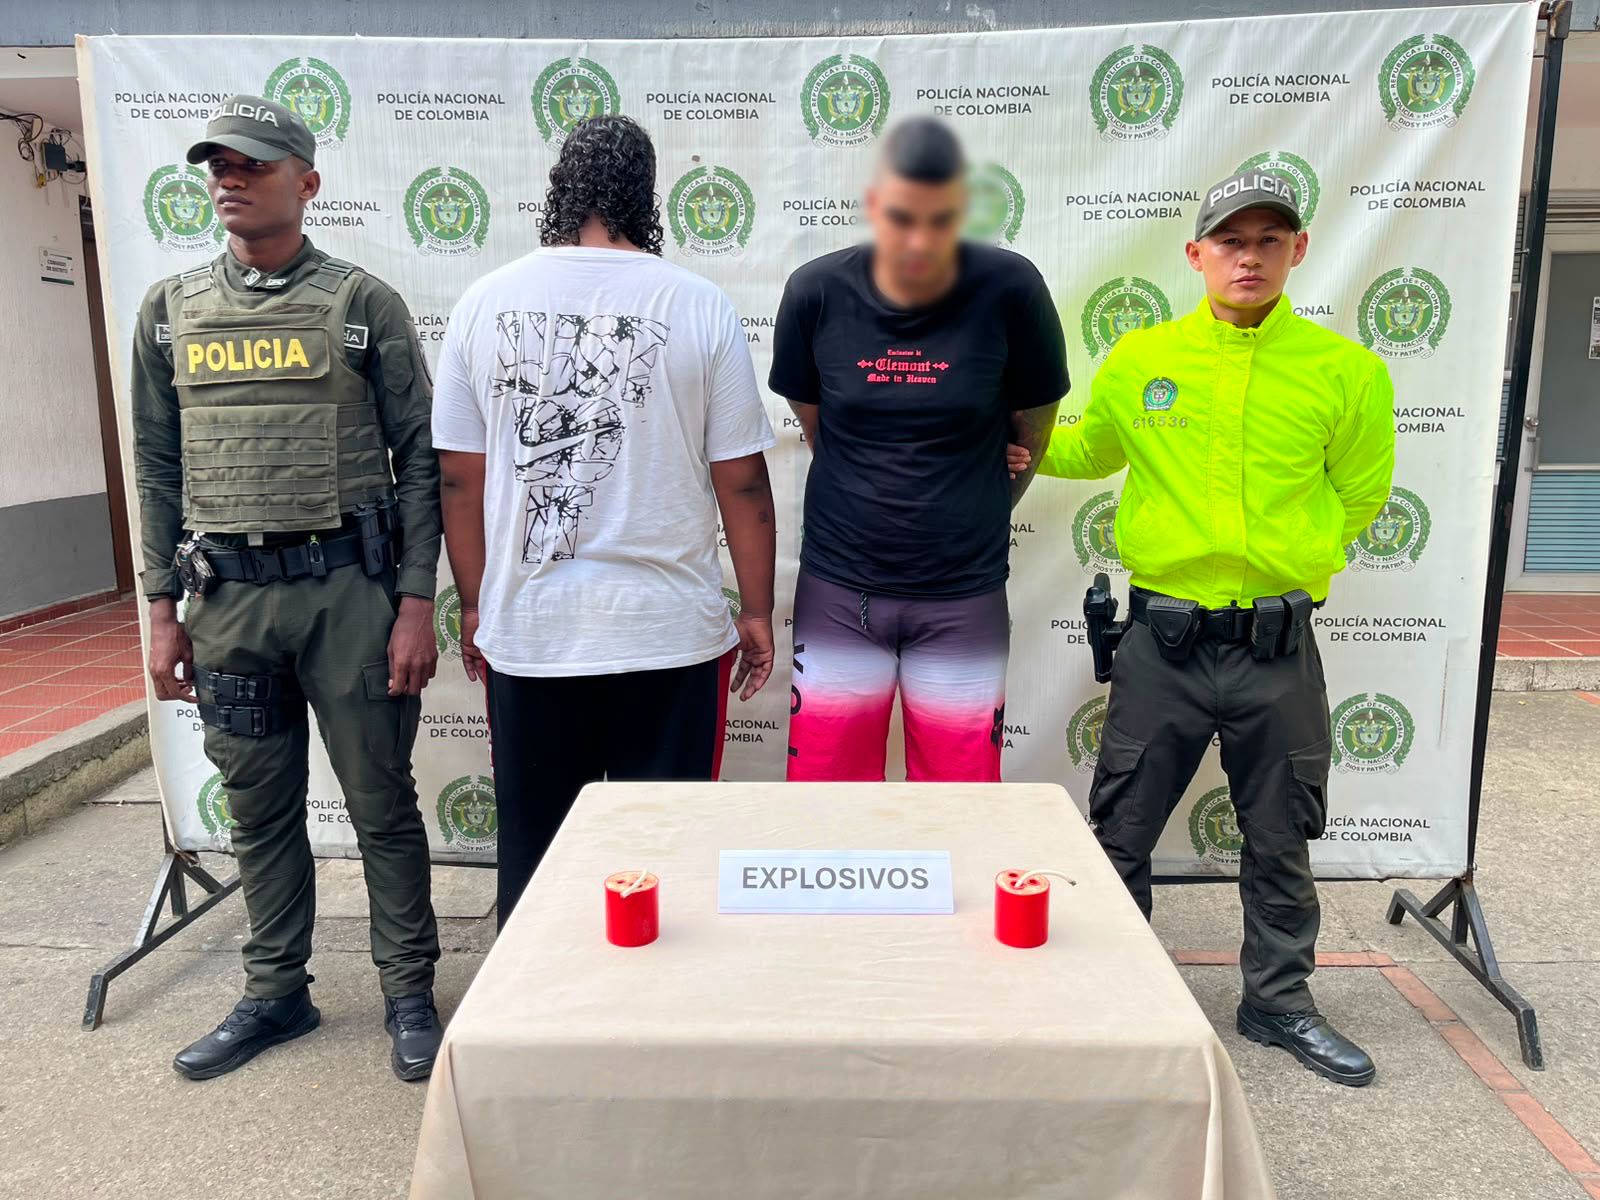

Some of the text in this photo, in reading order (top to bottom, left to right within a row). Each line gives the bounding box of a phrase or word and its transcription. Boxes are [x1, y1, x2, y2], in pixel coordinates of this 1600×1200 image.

[1390, 49, 1417, 88] REPUBLICA
[1442, 48, 1462, 85] COLOMBIA
[1101, 60, 1126, 100] REPUBLICA
[1151, 60, 1171, 97] COLOMBIA
[1212, 73, 1350, 88] POLICÍA NACIONAL
[275, 72, 294, 101] PUBLICA
[318, 73, 340, 109] COLOMBIA
[543, 72, 564, 109] REPUBLICA
[588, 72, 609, 109] COLOMBIA
[812, 68, 834, 106] REPUBLICA
[858, 69, 879, 105] COLOMBIA
[917, 85, 1050, 100] POLICÍA NACIONAL
[115, 91, 165, 103] POLICÍA
[377, 91, 505, 104] POLICÍA NACIONAL
[647, 90, 776, 103] POLICÍA NACIONAL
[1230, 92, 1330, 104] DE COLOMBIA
[934, 103, 1031, 116] DE COLOMBIA
[1424, 94, 1457, 118] NACIONAL
[131, 109, 213, 120] DE COLOMB
[395, 110, 489, 120] DE COLOMBIA
[664, 109, 759, 120] DE COLOMBIA
[1135, 107, 1167, 130] NACIONAL
[1423, 115, 1448, 127] PATRIA
[317, 118, 339, 139] ACIONAL
[845, 114, 876, 136] NACIONAL
[845, 134, 868, 145] PATRIA
[1135, 127, 1158, 139] PATRIA
[1287, 166, 1307, 202] COLOMBIA
[1350, 181, 1485, 196] POLICÍA NACIONAL
[1209, 174, 1294, 208] POLICÍA
[458, 182, 480, 217] COLOMBIA
[724, 181, 744, 216] COLOMBIA
[784, 197, 837, 210] POLICÍA
[1067, 191, 1200, 206] POLICÍA NACIONAL
[1368, 198, 1465, 210] DE COLOMBIA
[312, 201, 380, 211] NACIONAL
[1084, 207, 1182, 220] DE COLOMBIA
[303, 217, 365, 227] OLOMBIA
[800, 216, 817, 225] DE
[1369, 282, 1395, 319] REPUBLICA
[1420, 282, 1439, 317] COLOMBIA
[1093, 292, 1116, 328] REPUBLICA
[1140, 292, 1160, 326] COLOMBI
[1293, 305, 1334, 317] ONAL
[412, 314, 443, 326] LICÍA
[740, 317, 776, 327] ONAL
[1402, 326, 1435, 348] NACIONAL
[187, 338, 309, 373] POLICIA
[1401, 346, 1425, 356] PATRIA
[875, 358, 930, 371] Clemont
[867, 373, 937, 384] Made in Heaven
[1133, 416, 1188, 430] 616536
[1395, 423, 1446, 433] OMBIA
[1084, 504, 1107, 538] REPUBLICA
[1051, 619, 1089, 630] POLIC
[1315, 616, 1446, 627] POLICÍA NACIONAL
[1068, 635, 1085, 644] DE
[1331, 632, 1426, 641] DE COLOMBIA
[725, 720, 779, 730] ACIONAL
[1383, 706, 1402, 738] COLOMBIA
[431, 728, 447, 737] DE
[724, 733, 764, 743] OMBIA
[319, 814, 334, 823] DE
[1326, 815, 1430, 828] LICÍA NACIONAL
[1319, 831, 1412, 841] DE COLOMBIA
[742, 867, 929, 890] EXPLOSIVOS
